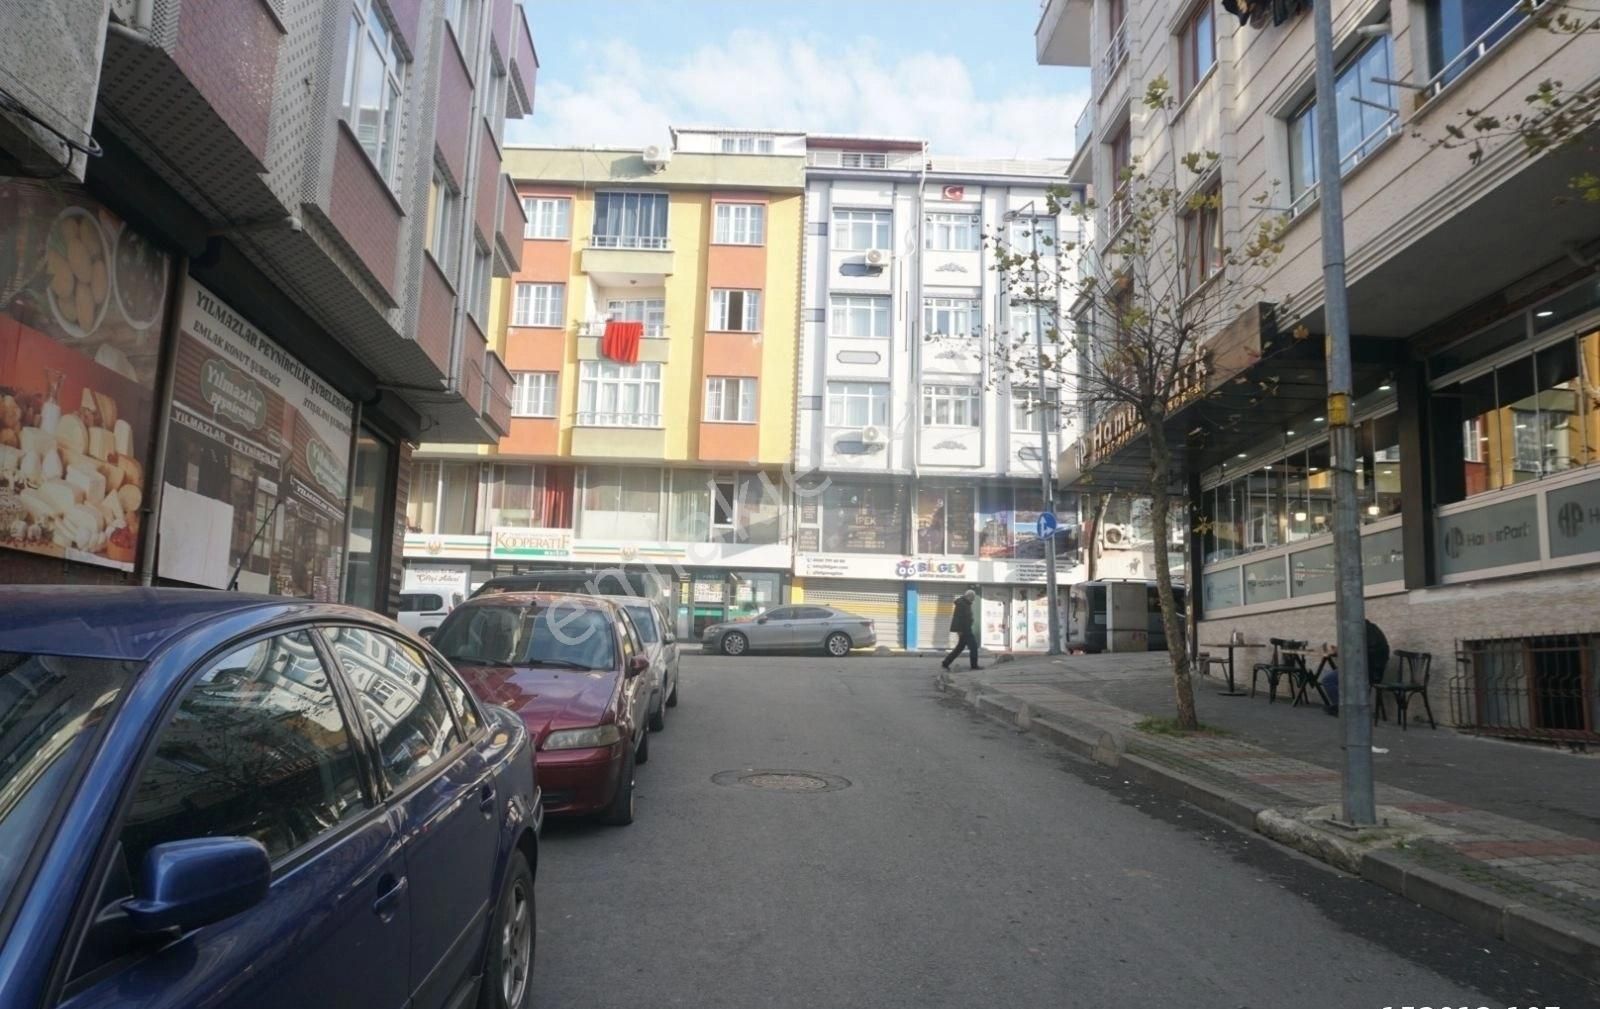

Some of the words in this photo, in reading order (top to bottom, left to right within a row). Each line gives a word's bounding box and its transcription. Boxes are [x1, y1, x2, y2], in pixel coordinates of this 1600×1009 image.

[192, 319, 224, 350] EMLAK
[224, 341, 251, 366] KONUT
[195, 290, 257, 348] YILMAZLAR
[258, 338, 311, 388] PEYNİRCİLİK
[175, 410, 227, 444] YILMAZLAR
